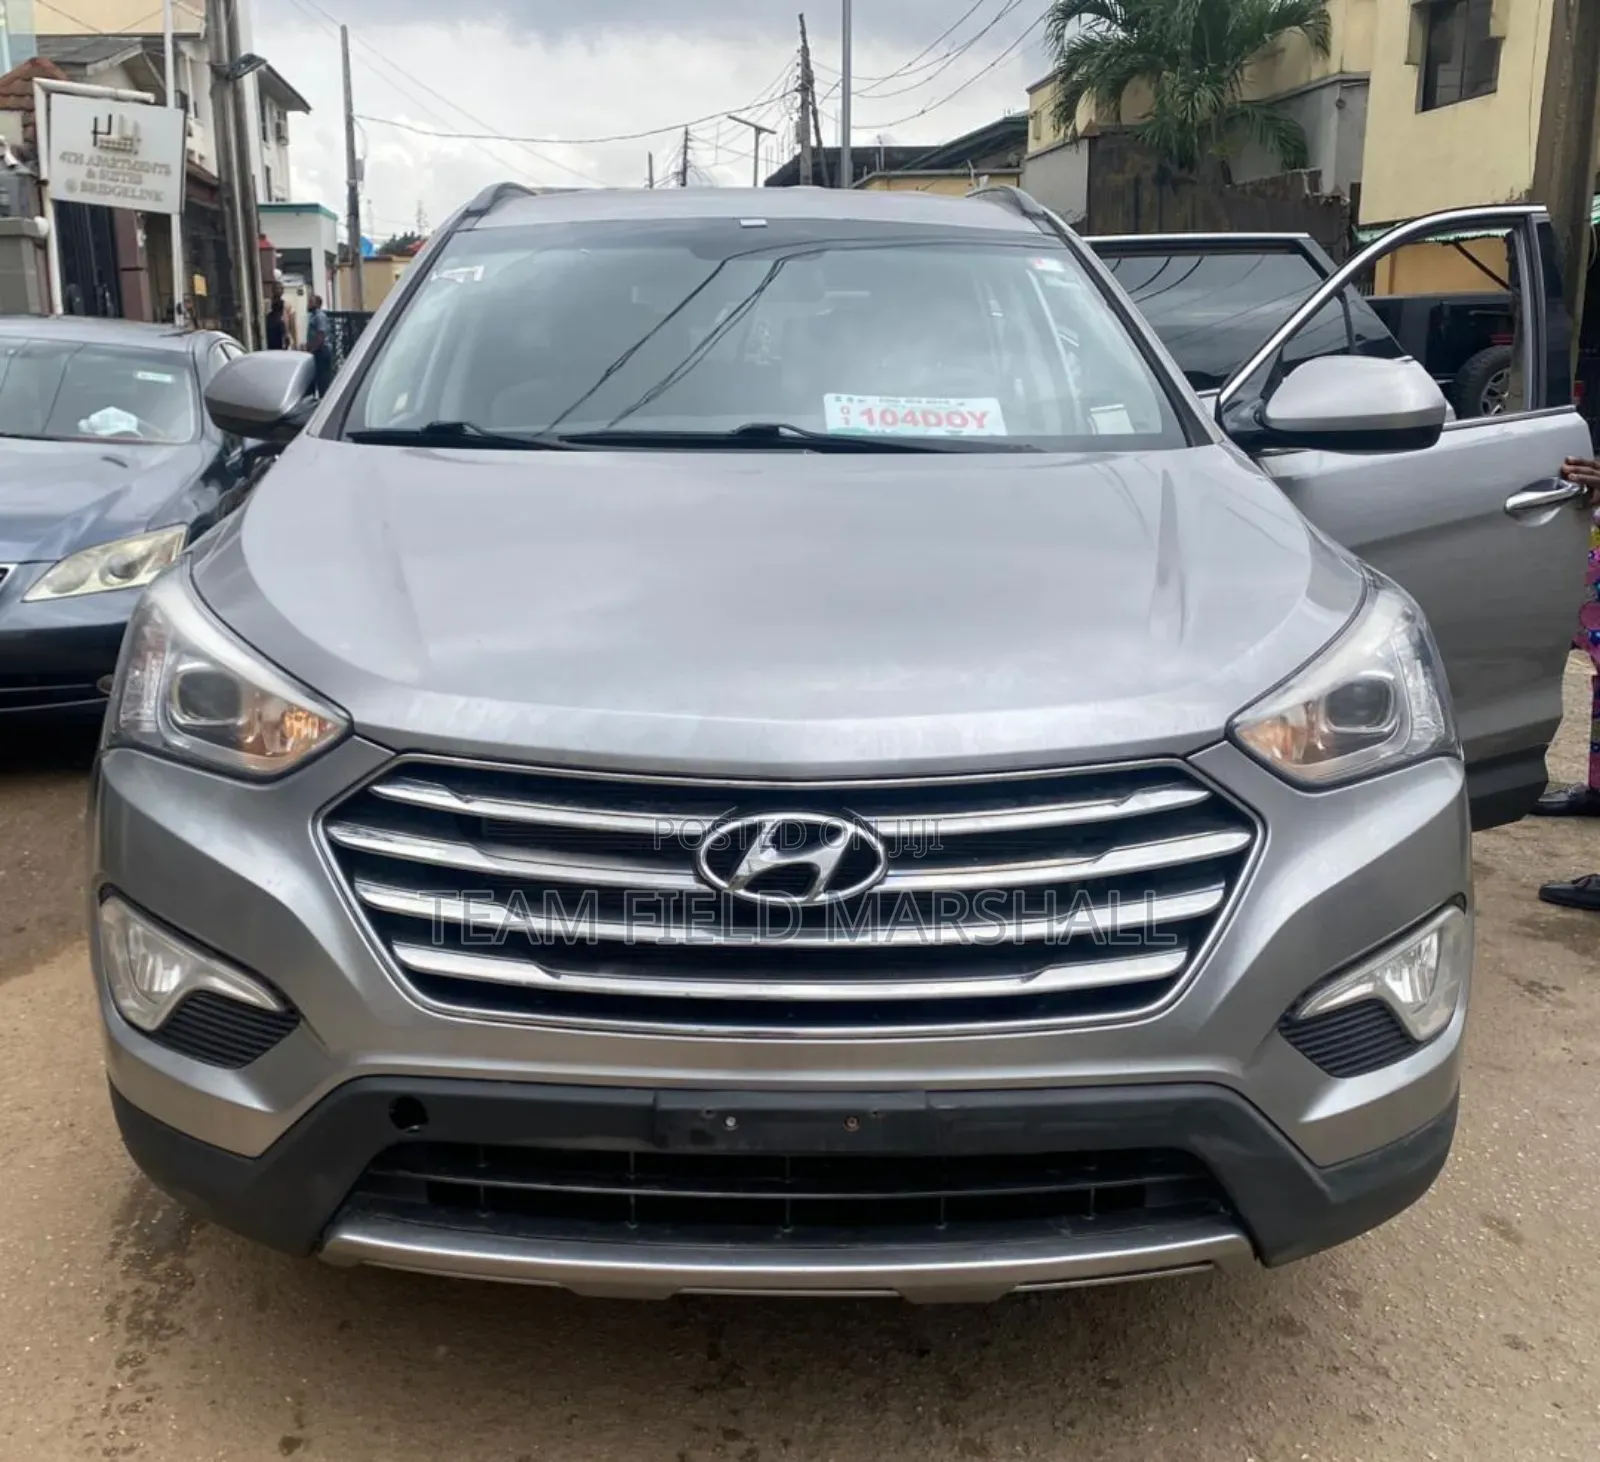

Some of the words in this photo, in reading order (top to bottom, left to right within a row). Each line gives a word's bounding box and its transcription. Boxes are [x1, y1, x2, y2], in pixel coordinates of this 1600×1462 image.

[86, 154, 172, 177] APARTMENTS
[99, 169, 143, 185] SUITES
[859, 407, 989, 429] 104DOY
